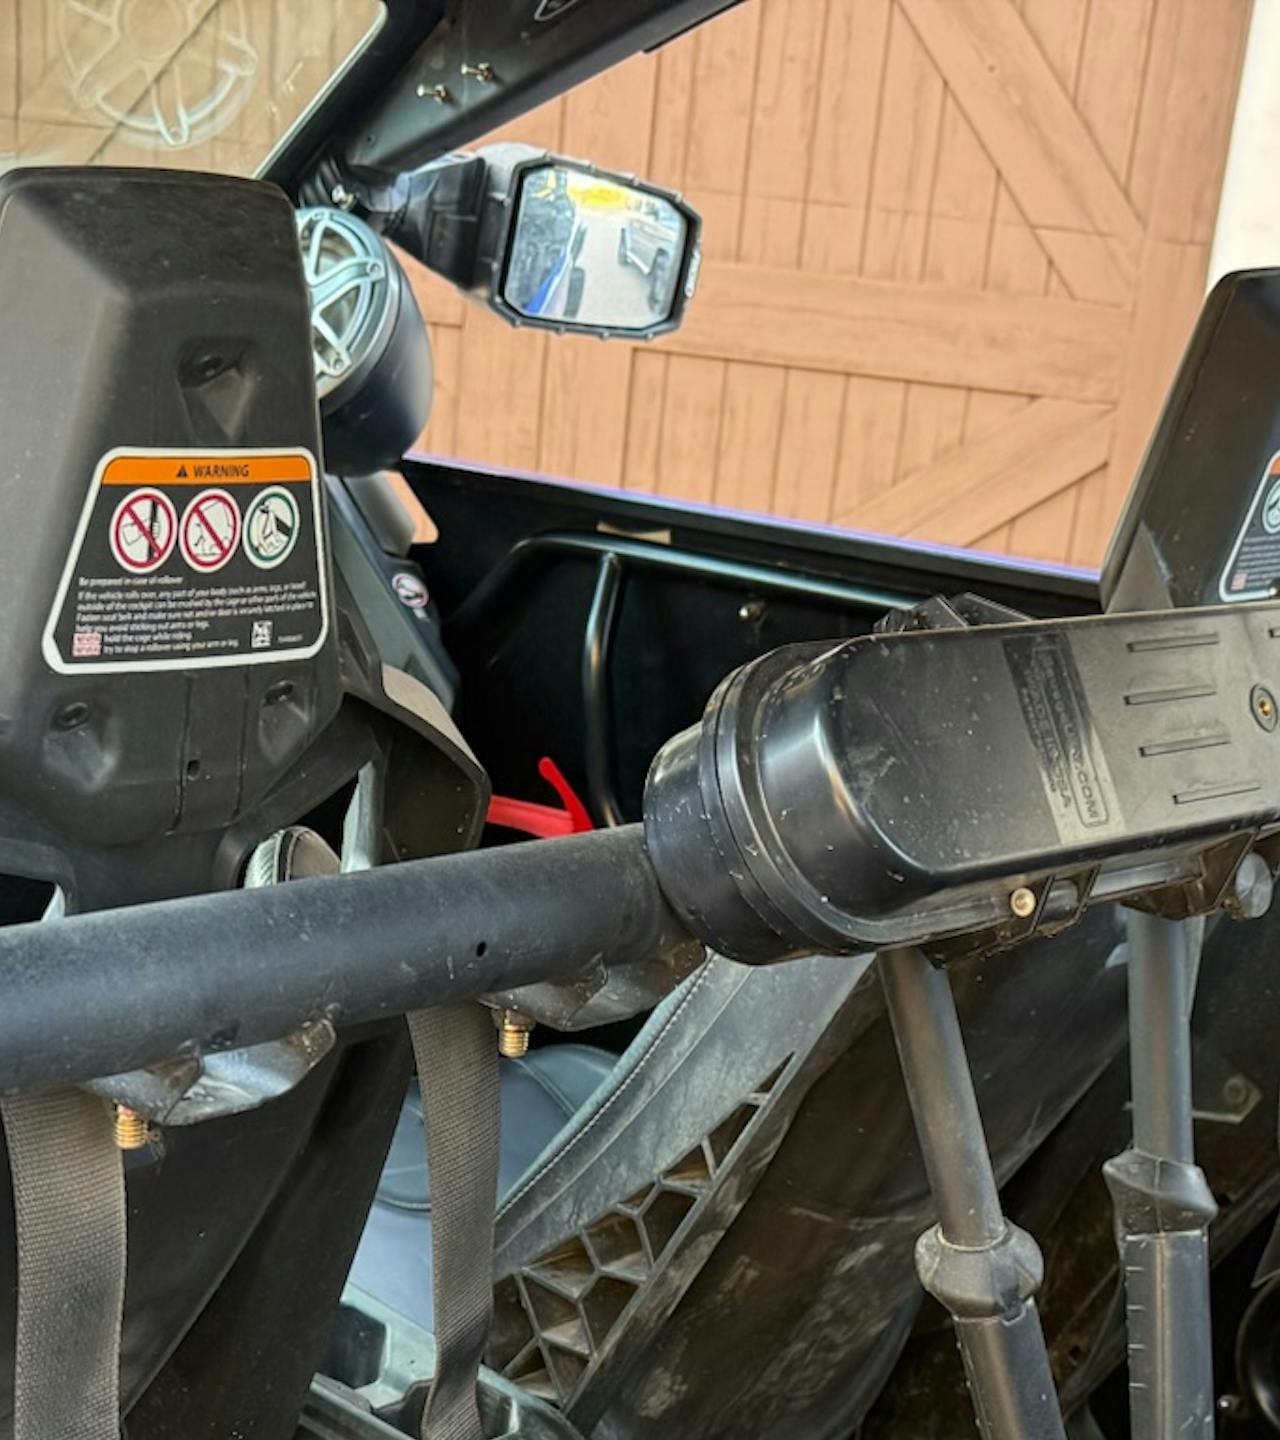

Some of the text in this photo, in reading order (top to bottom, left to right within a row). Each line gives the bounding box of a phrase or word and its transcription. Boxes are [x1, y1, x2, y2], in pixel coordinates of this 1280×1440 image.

[193, 463, 250, 478] WARNING
[79, 577, 89, 587] Be
[90, 577, 123, 588] prepared
[132, 578, 148, 586] case
[149, 576, 157, 585] of
[85, 591, 97, 600] the
[98, 591, 123, 600] vehicle
[159, 591, 171, 601] any
[173, 590, 186, 600] part
[187, 588, 196, 598] of
[195, 590, 210, 599] your
[77, 602, 104, 611] outside
[106, 601, 115, 610] of
[115, 602, 127, 610] the
[75, 612, 101, 622] Fasten
[102, 613, 117, 622] seat
[118, 612, 132, 621] belt
[133, 612, 147, 620] and
[148, 611, 166, 620] make
[75, 624, 93, 633] help
[109, 624, 129, 632] avoid
[130, 622, 157, 633] sticking
[158, 622, 170, 630] out
[170, 622, 187, 630] arms
[104, 634, 121, 642] hold
[135, 634, 151, 643] cage
[152, 632, 170, 641] while
